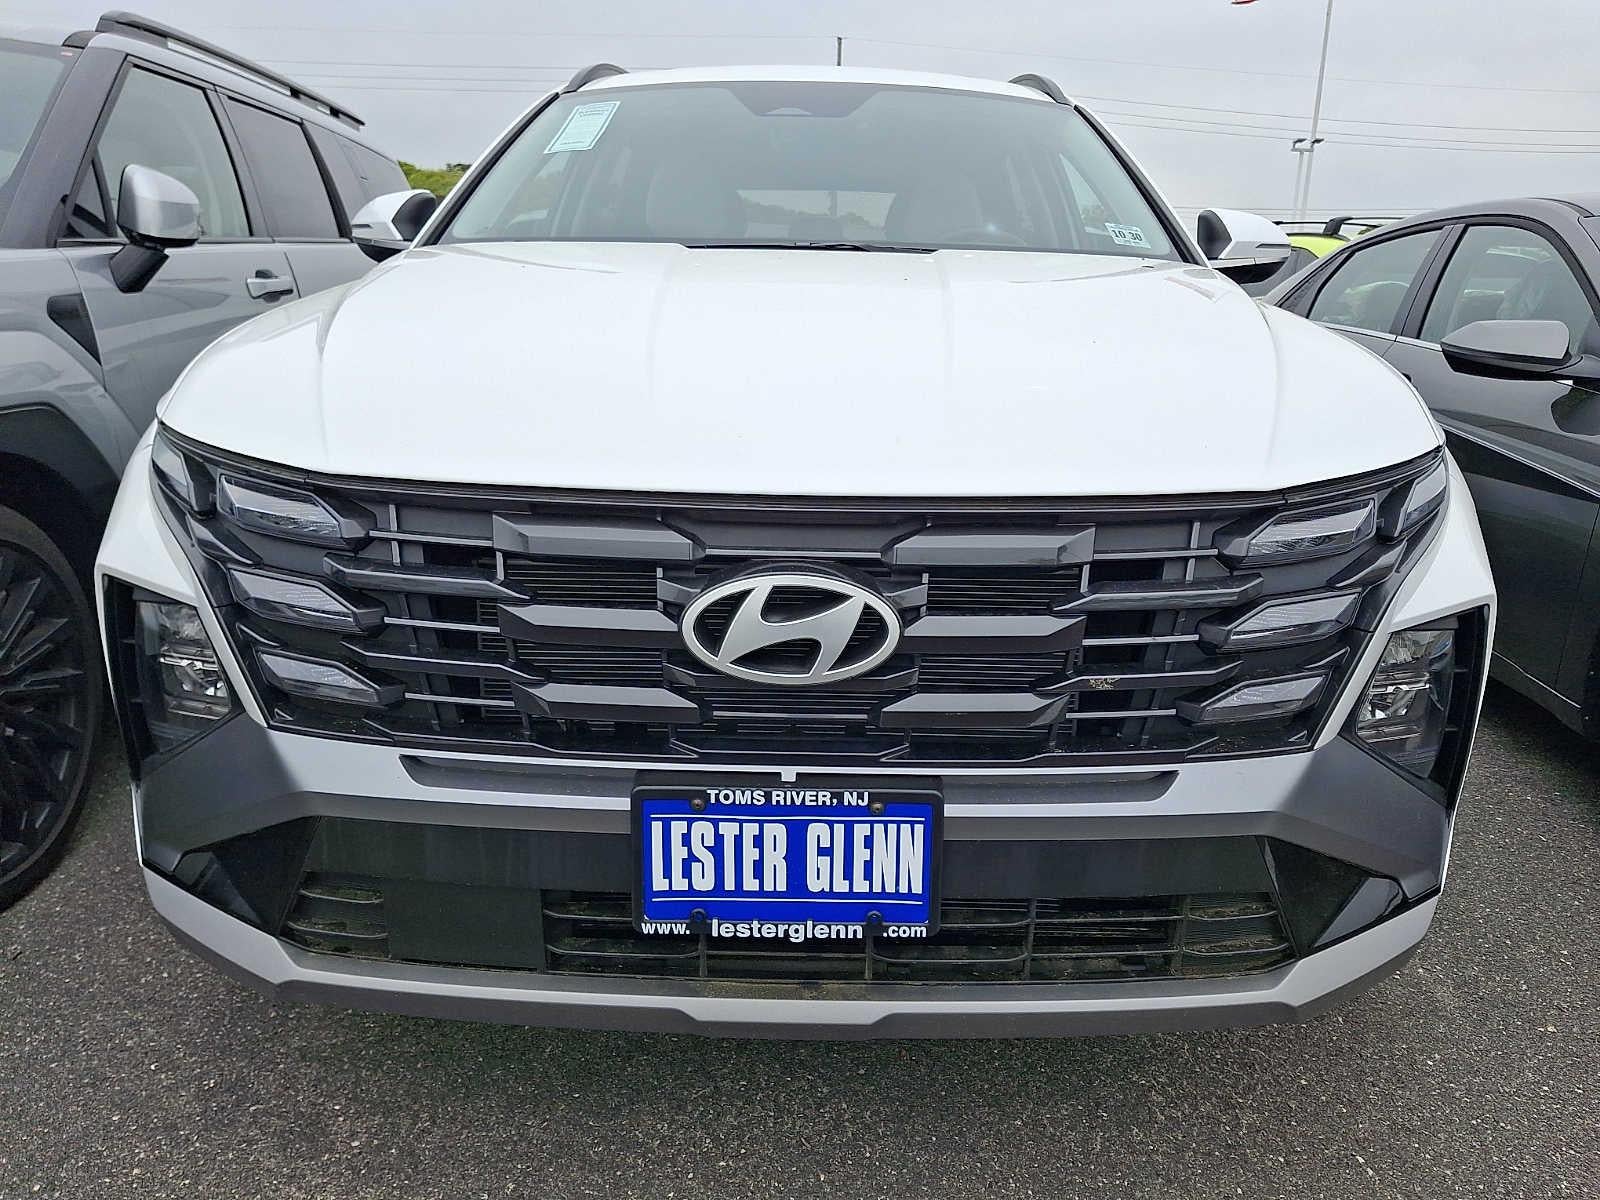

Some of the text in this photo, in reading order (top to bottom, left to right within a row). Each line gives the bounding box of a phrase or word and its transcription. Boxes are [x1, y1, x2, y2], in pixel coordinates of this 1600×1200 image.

[1112, 230, 1143, 241] 10 30
[707, 789, 869, 807] TOMS RIVER, NJ
[652, 821, 924, 894] LESTER GLENN
[641, 919, 927, 942] www. lesterglenn .com
